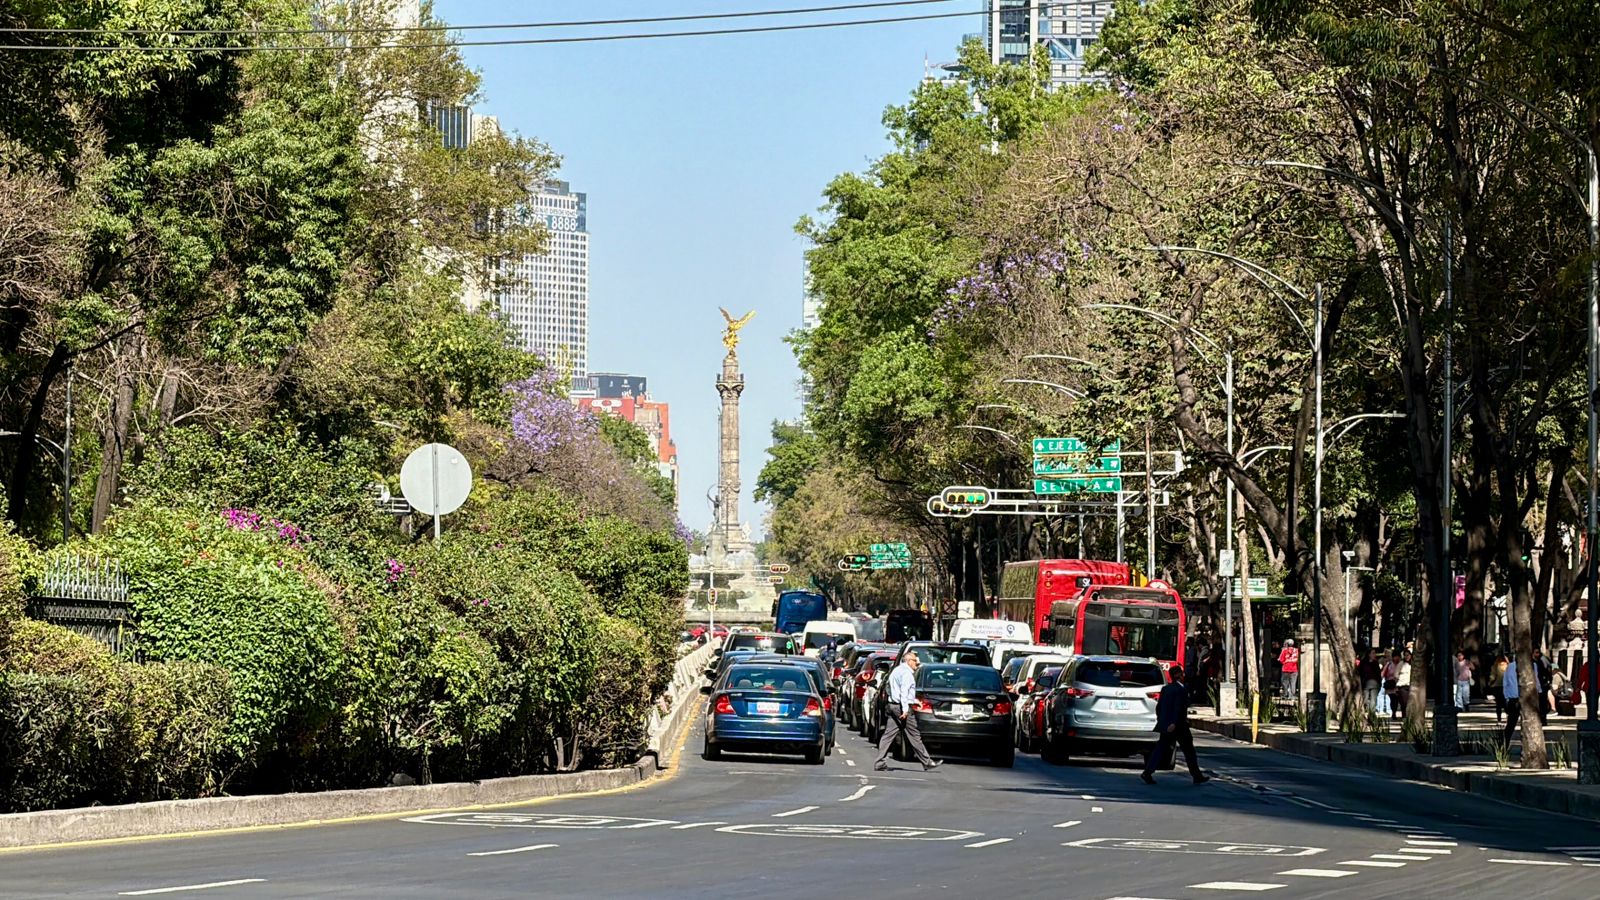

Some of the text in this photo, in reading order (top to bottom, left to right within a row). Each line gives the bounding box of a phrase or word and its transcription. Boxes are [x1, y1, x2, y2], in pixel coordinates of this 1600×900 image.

[551, 215, 577, 231] 8888
[1048, 441, 1065, 450] EJE
[1067, 441, 1073, 450] 2
